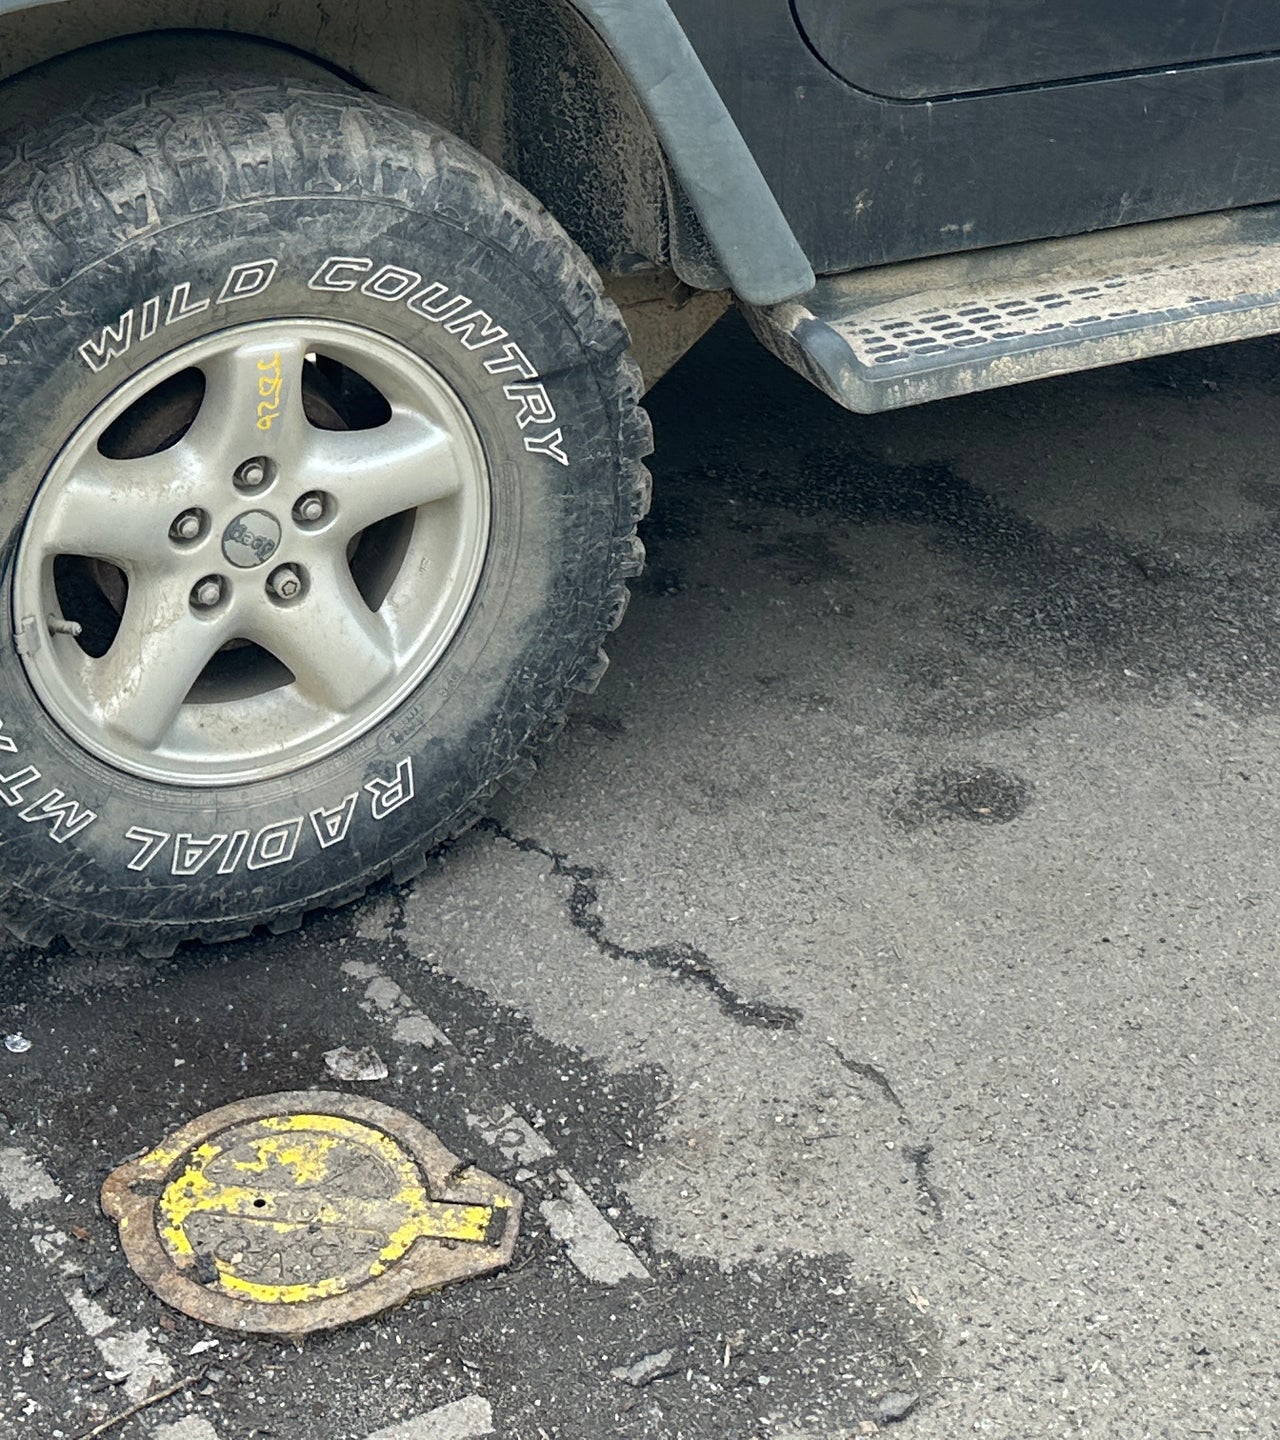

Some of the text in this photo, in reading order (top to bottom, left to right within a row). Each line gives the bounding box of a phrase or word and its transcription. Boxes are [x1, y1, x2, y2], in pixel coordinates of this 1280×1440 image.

[77, 256, 571, 467] WILD COUNTRY
[125, 755, 416, 878] RADIAL
